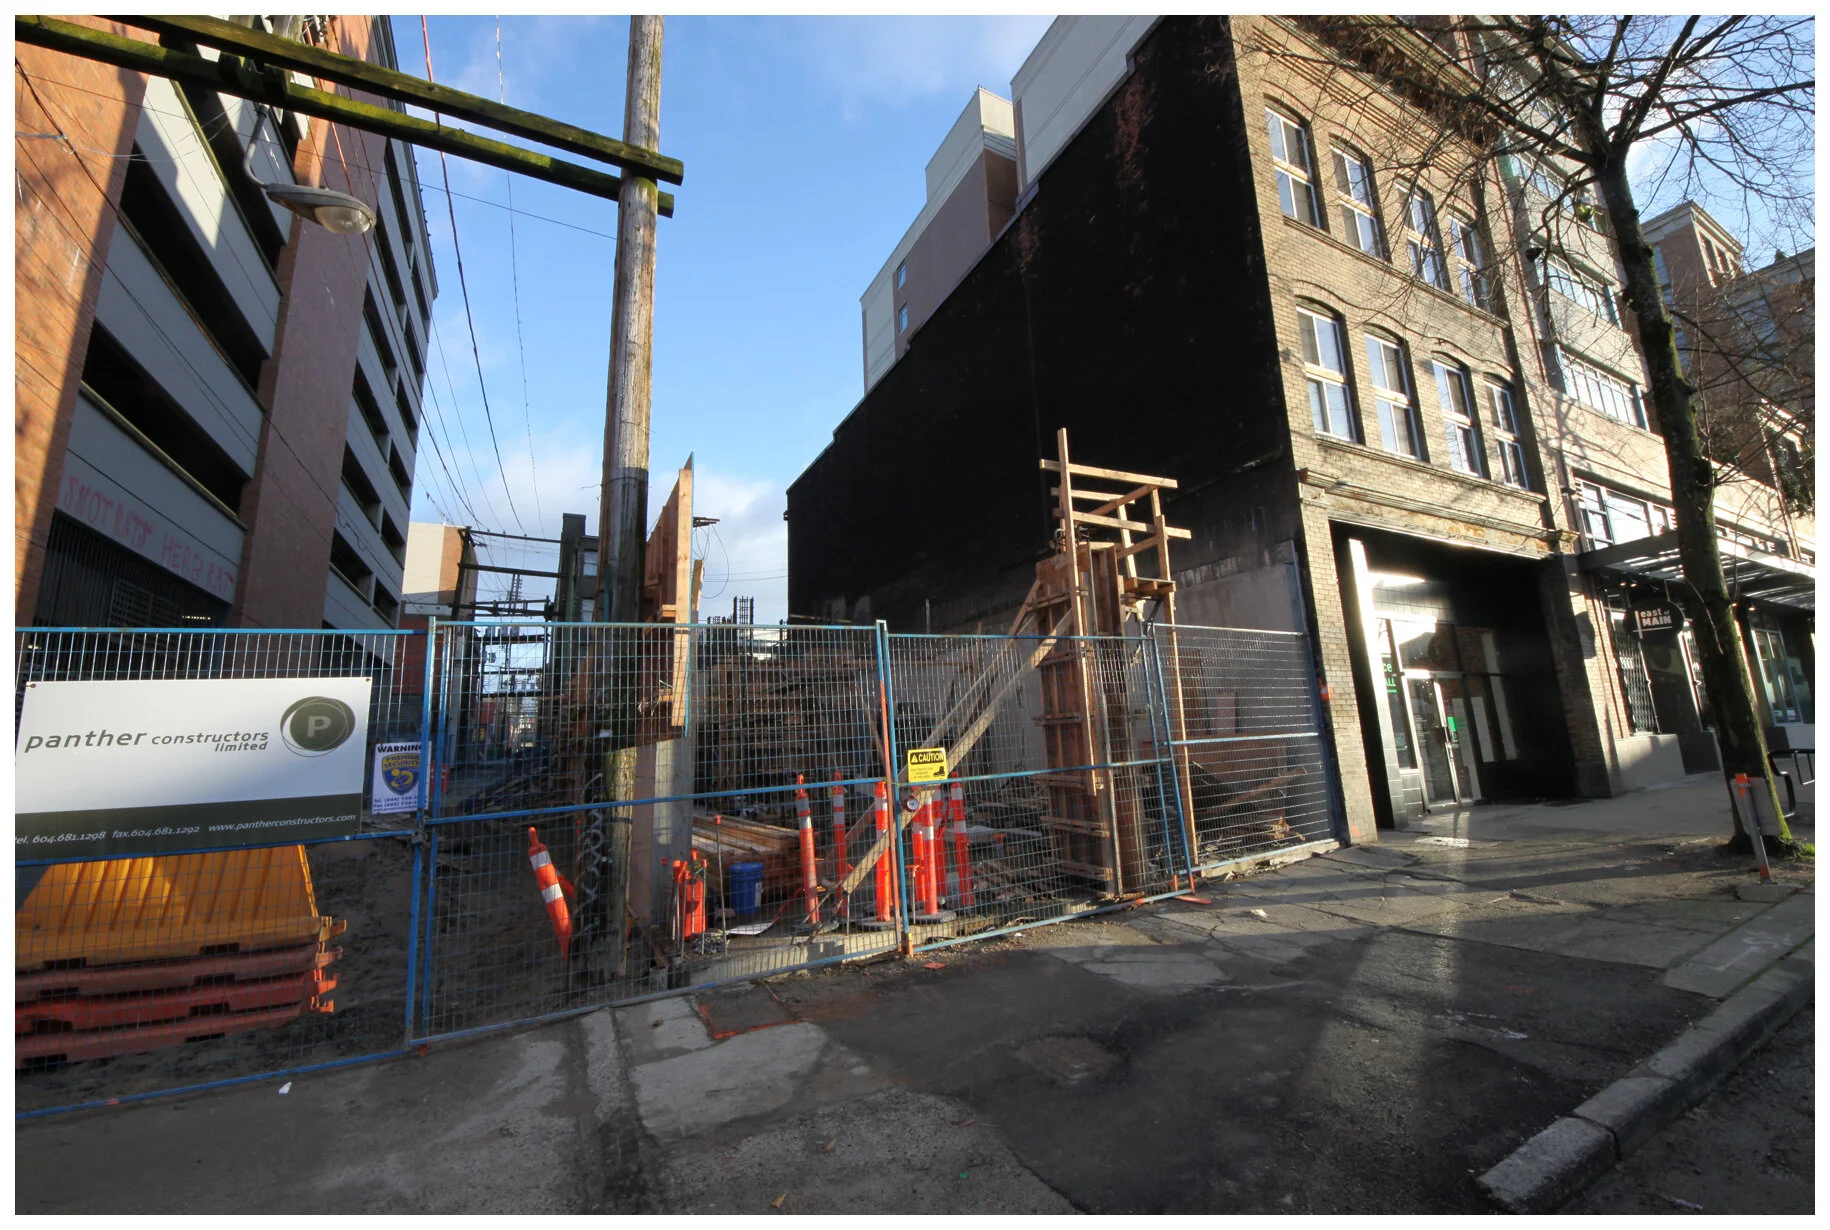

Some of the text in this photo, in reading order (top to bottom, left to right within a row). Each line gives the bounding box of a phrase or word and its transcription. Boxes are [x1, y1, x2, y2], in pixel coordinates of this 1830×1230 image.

[1640, 608, 1662, 618] east
[1642, 615, 1672, 626] MAIN
[307, 715, 332, 738] P
[24, 729, 269, 753] panther constructors
[214, 741, 268, 753] limited
[377, 745, 422, 753] WARNIN
[918, 752, 944, 763] CAUTION
[32, 831, 106, 845] 604.681.1298
[112, 826, 200, 839] fax.604.681.1292
[208, 814, 356, 831] www.pantherconstructors.com
